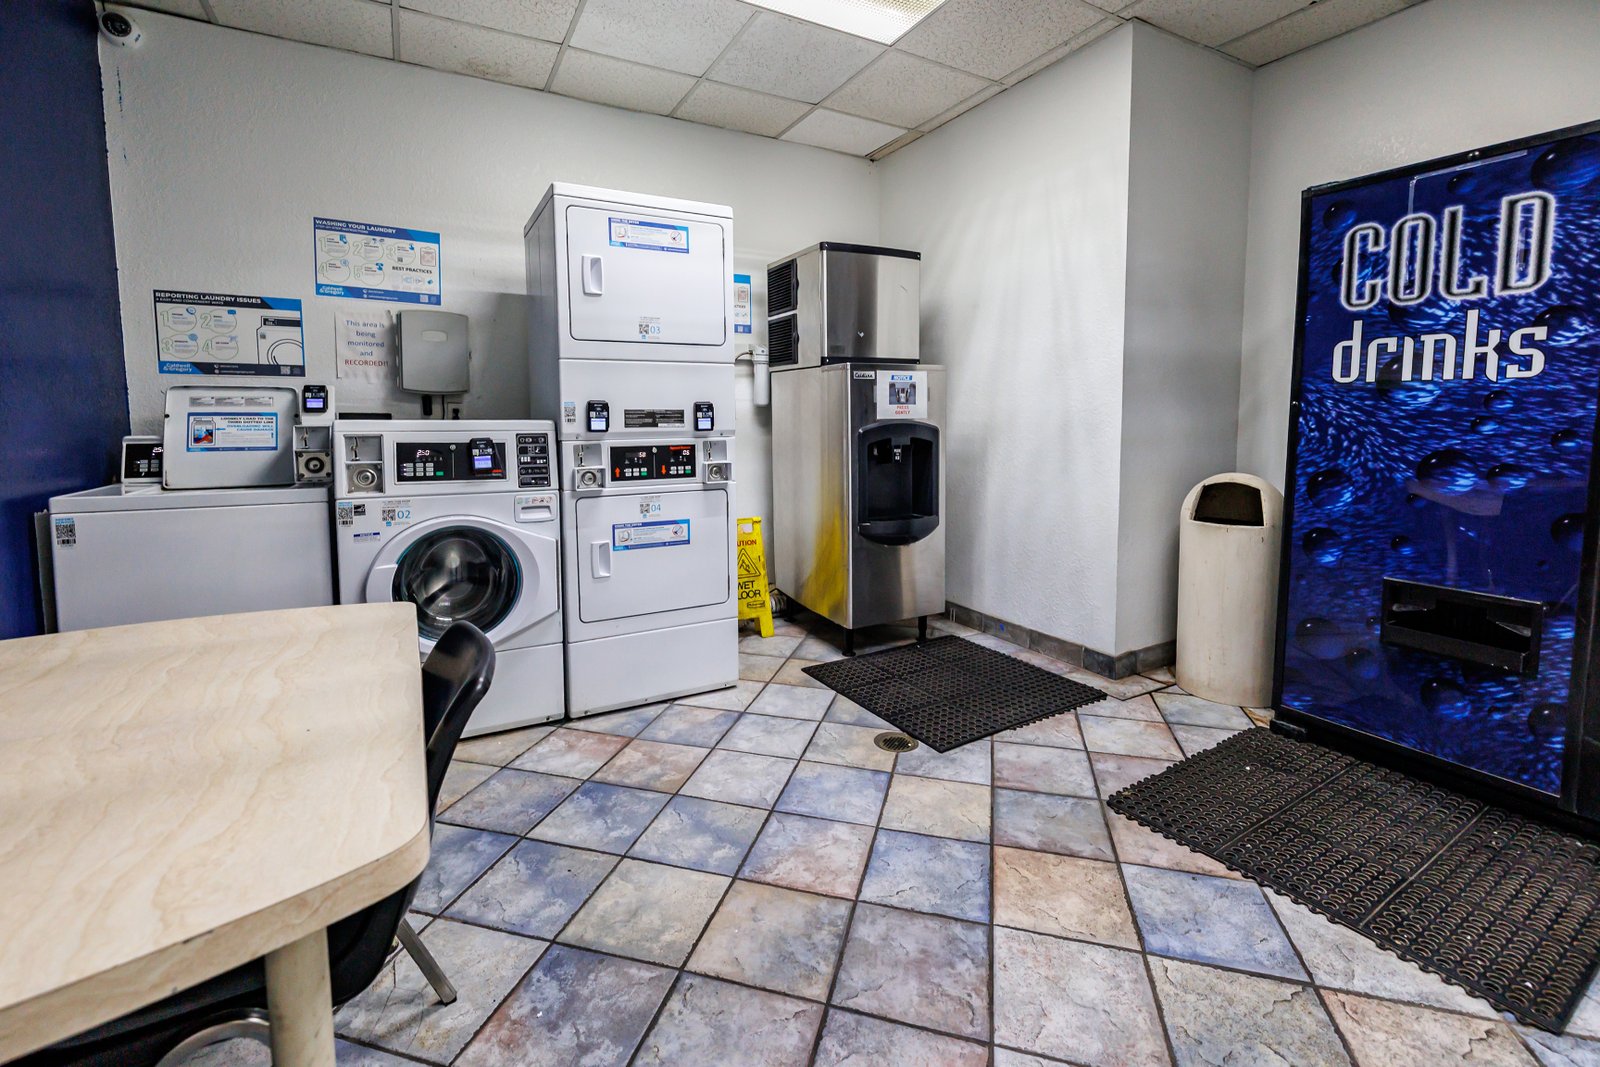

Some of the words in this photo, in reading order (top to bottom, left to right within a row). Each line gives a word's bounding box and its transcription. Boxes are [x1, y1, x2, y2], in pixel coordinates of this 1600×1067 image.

[315, 219, 347, 228] WASHING
[367, 226, 396, 234] LAUNDRY
[1340, 190, 1556, 311] COLD
[155, 292, 199, 300] REPORTING
[200, 294, 235, 302] LAUNDRY
[355, 330, 376, 338] being
[650, 326, 660, 334] 03
[347, 340, 385, 348] monitored
[1331, 309, 1548, 383] drinks
[650, 504, 661, 512] 04
[397, 510, 411, 519] 02
[737, 539, 757, 547] UTION
